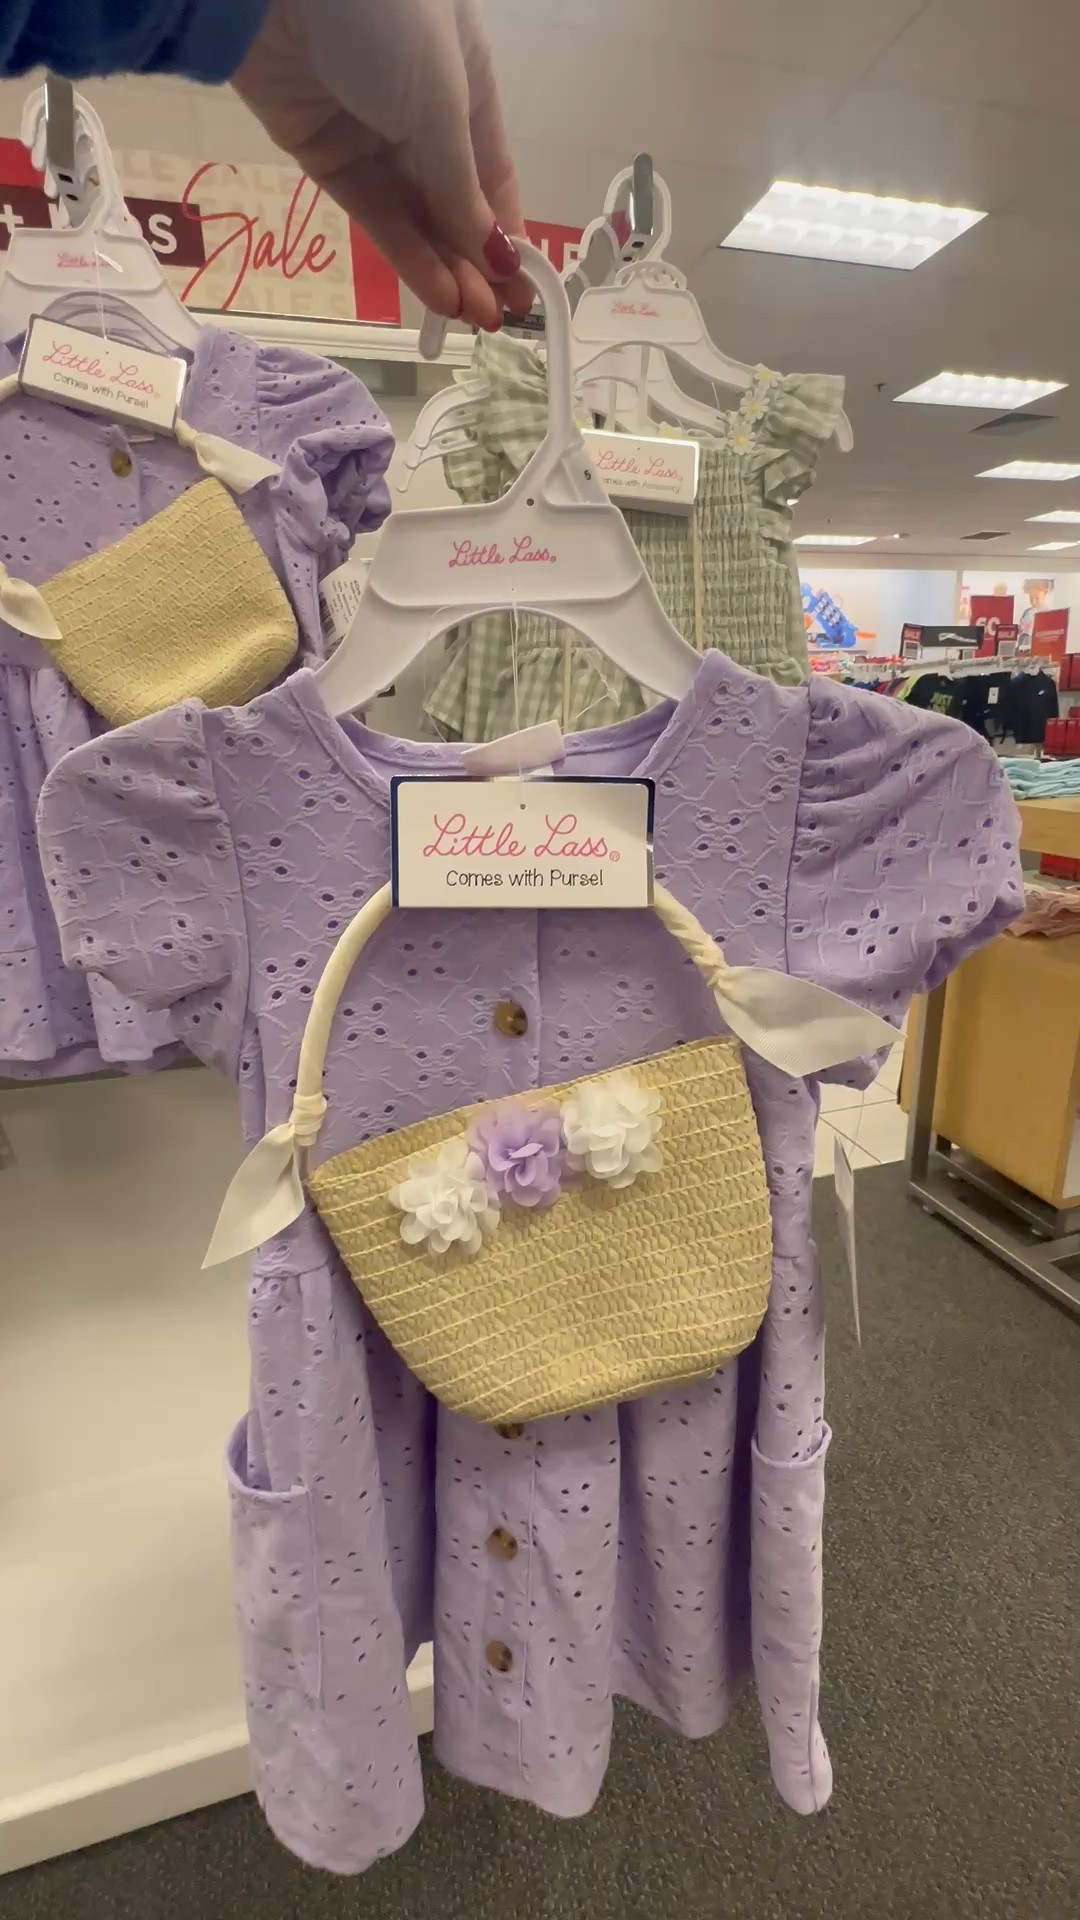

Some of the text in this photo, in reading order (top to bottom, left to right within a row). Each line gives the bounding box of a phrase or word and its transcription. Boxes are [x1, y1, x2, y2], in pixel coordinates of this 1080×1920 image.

[181, 162, 336, 311] Sale
[42, 341, 105, 378] Little
[54, 372, 89, 391] Comes
[92, 386, 114, 399] with
[596, 449, 640, 474] Little
[449, 540, 505, 568] Little
[423, 813, 527, 857] Little
[446, 869, 504, 887] Comes
[508, 868, 544, 887] with
